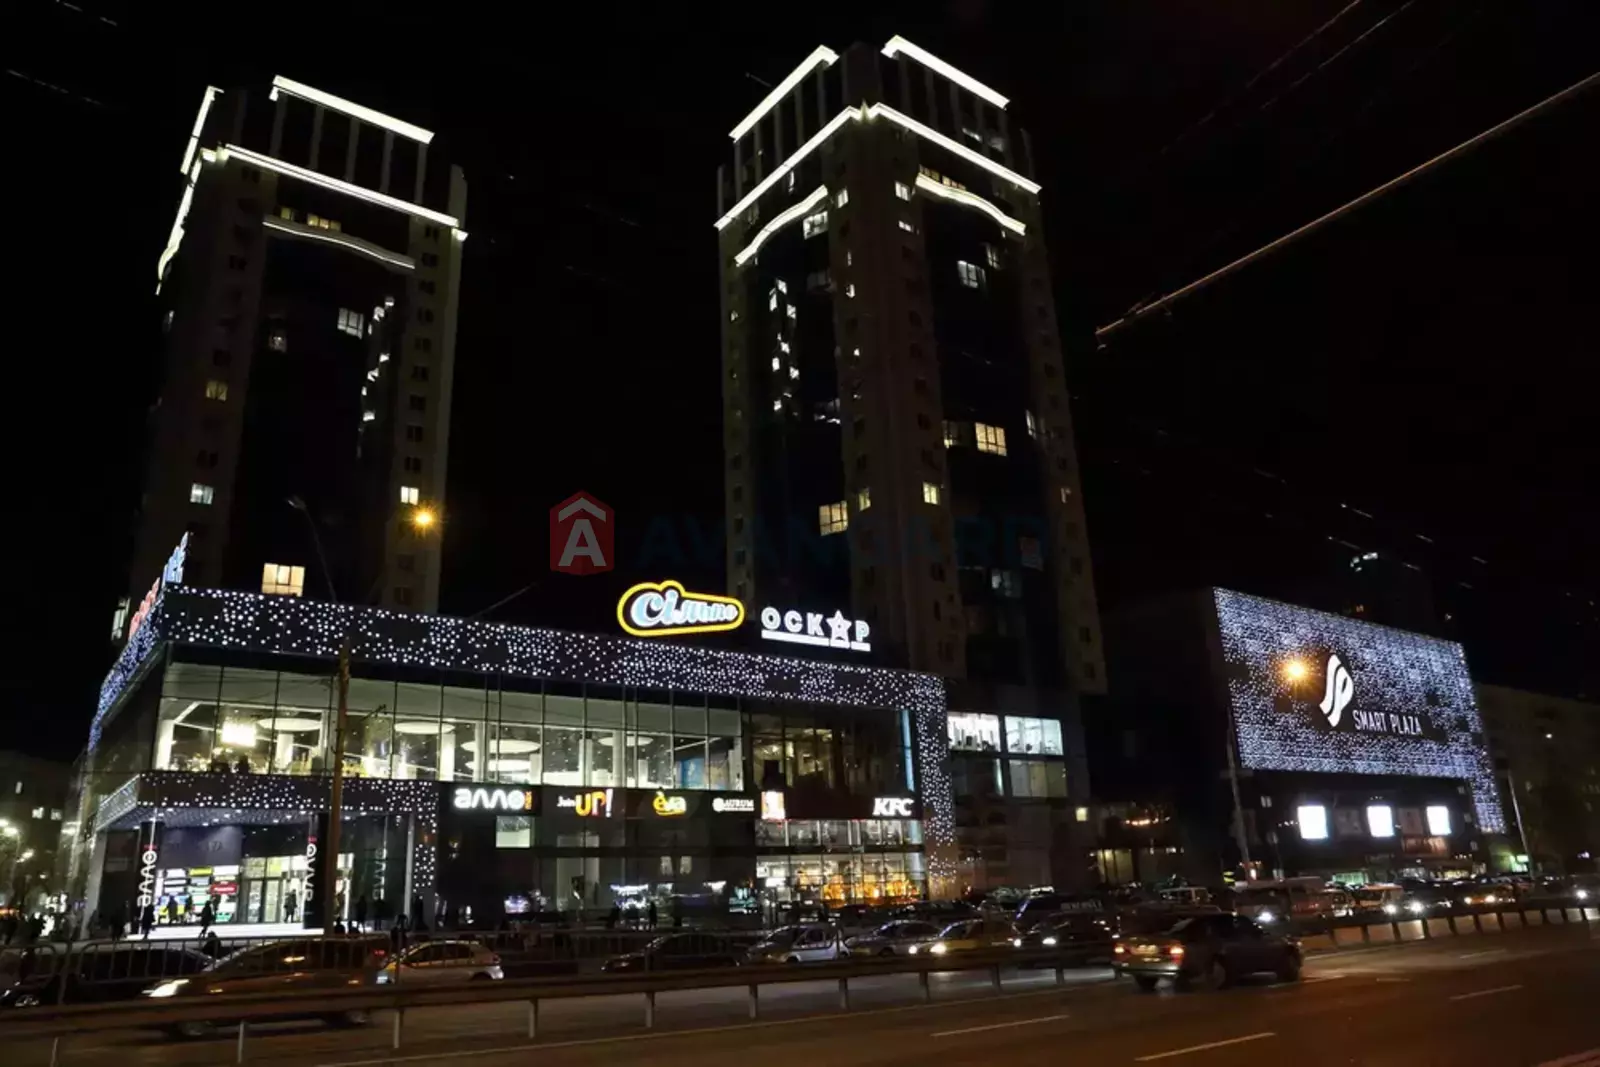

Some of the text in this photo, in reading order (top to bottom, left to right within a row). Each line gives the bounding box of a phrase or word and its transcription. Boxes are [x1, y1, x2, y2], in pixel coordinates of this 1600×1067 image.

[1352, 709, 1423, 735] SMART PLAZA
[873, 797, 914, 816] KFC
